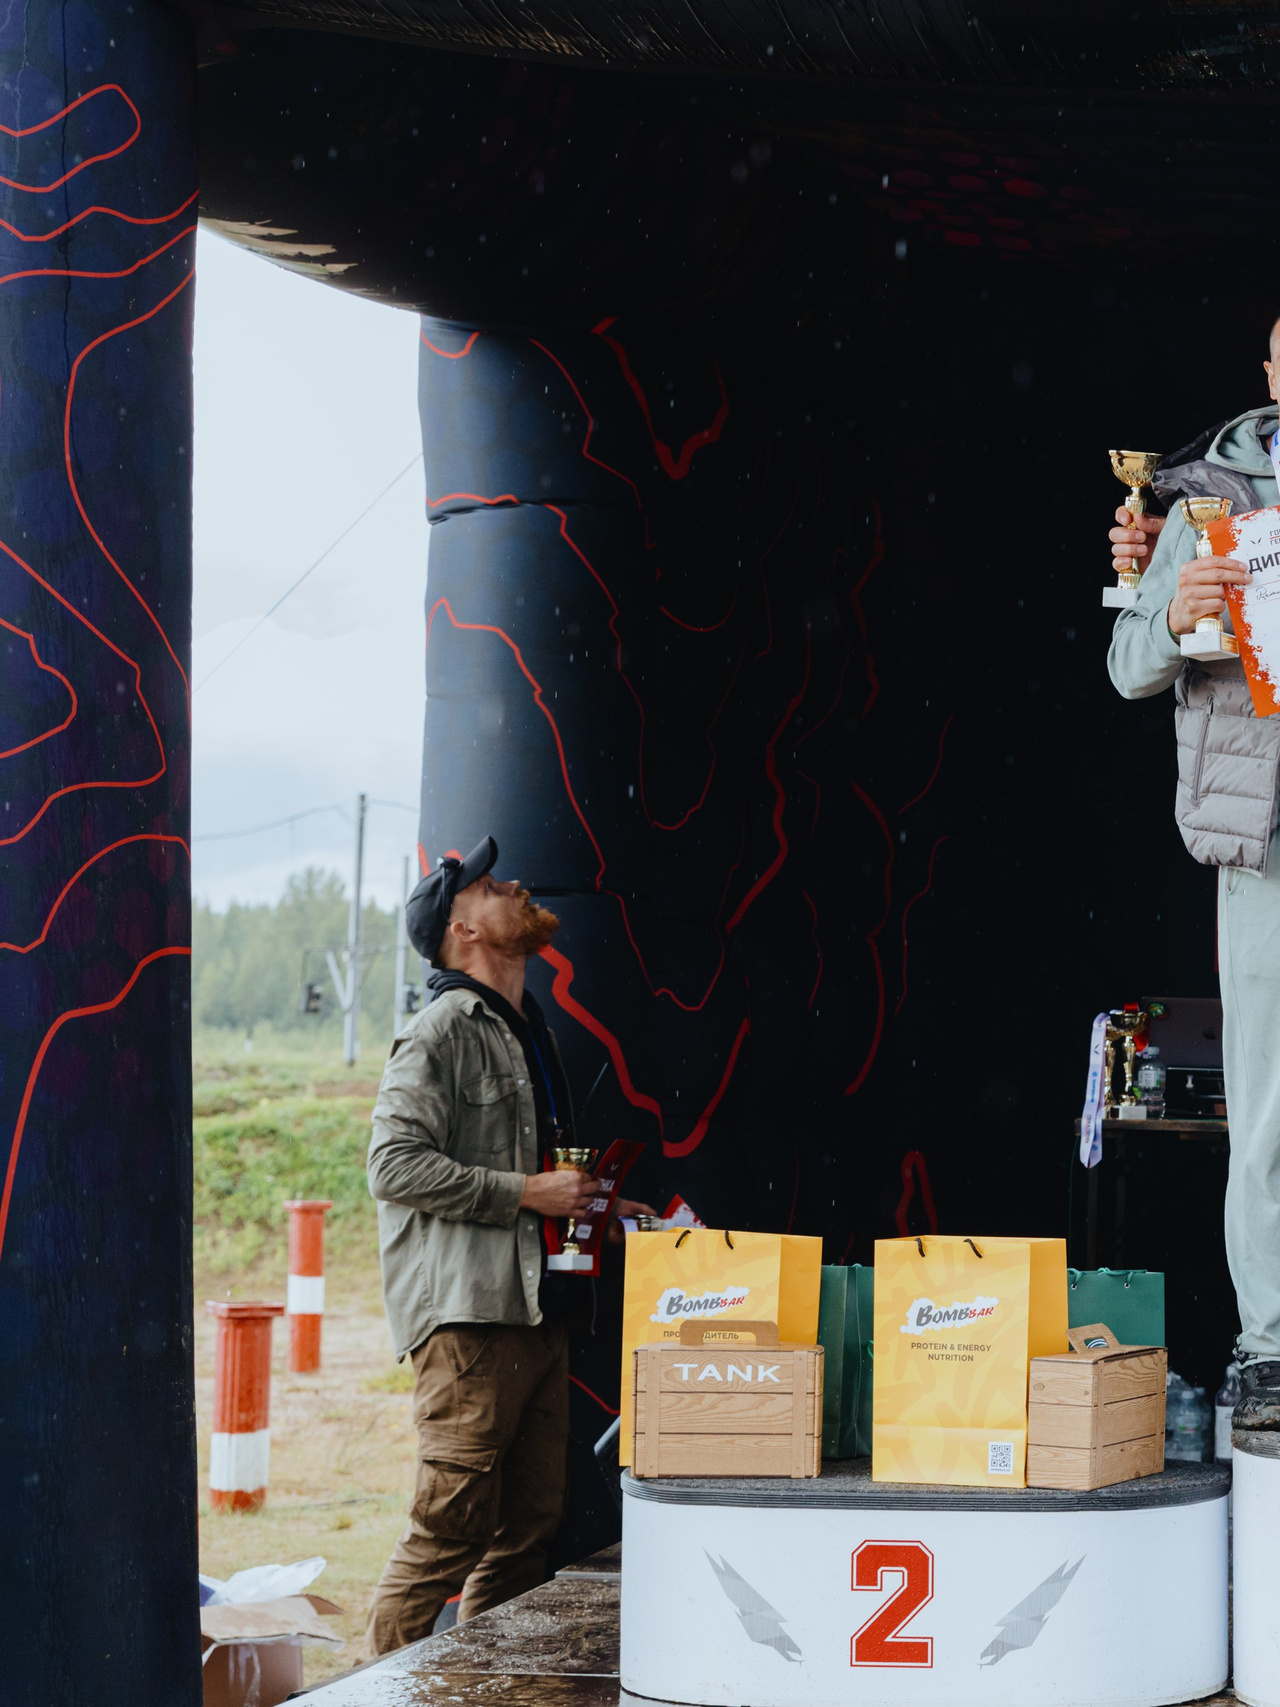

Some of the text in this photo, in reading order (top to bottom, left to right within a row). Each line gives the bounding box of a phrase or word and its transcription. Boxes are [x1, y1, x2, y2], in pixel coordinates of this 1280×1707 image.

[663, 1330, 740, 1341] ПРОДИТЕЛЬ
[911, 1342, 992, 1352] PROTEIN & ENERGY
[928, 1353, 974, 1362] NUTRITION
[673, 1363, 781, 1383] TANK
[850, 1539, 935, 1668] 2
